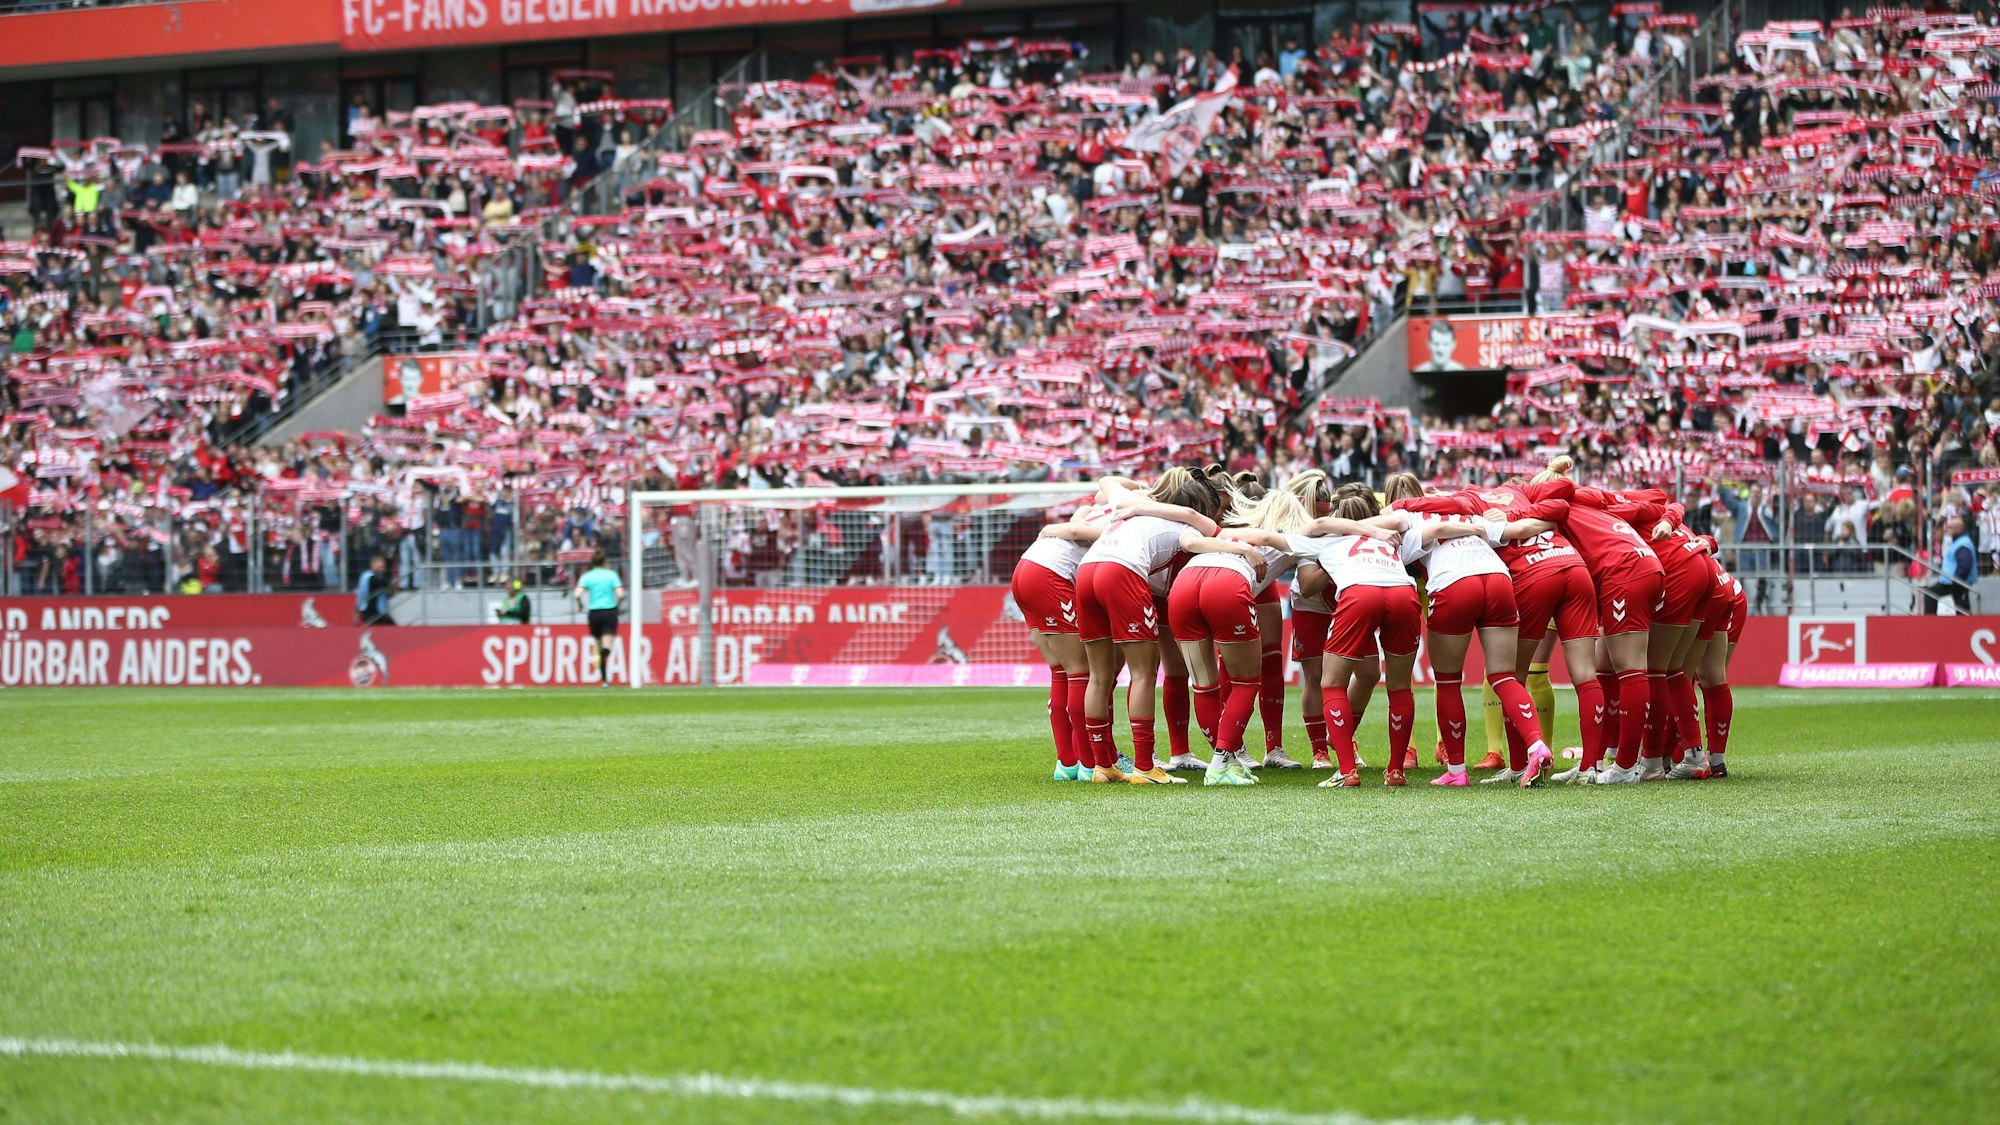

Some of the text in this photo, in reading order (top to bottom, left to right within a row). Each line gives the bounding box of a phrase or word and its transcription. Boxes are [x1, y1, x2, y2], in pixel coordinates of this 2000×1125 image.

[343, 0, 488, 36] FC-FANS
[500, 0, 618, 26] GEGEN
[0, 632, 262, 685] ÜRBAR ANDERS.
[1802, 666, 1877, 682] MAGENTA
[1878, 665, 1928, 682] SPORT
